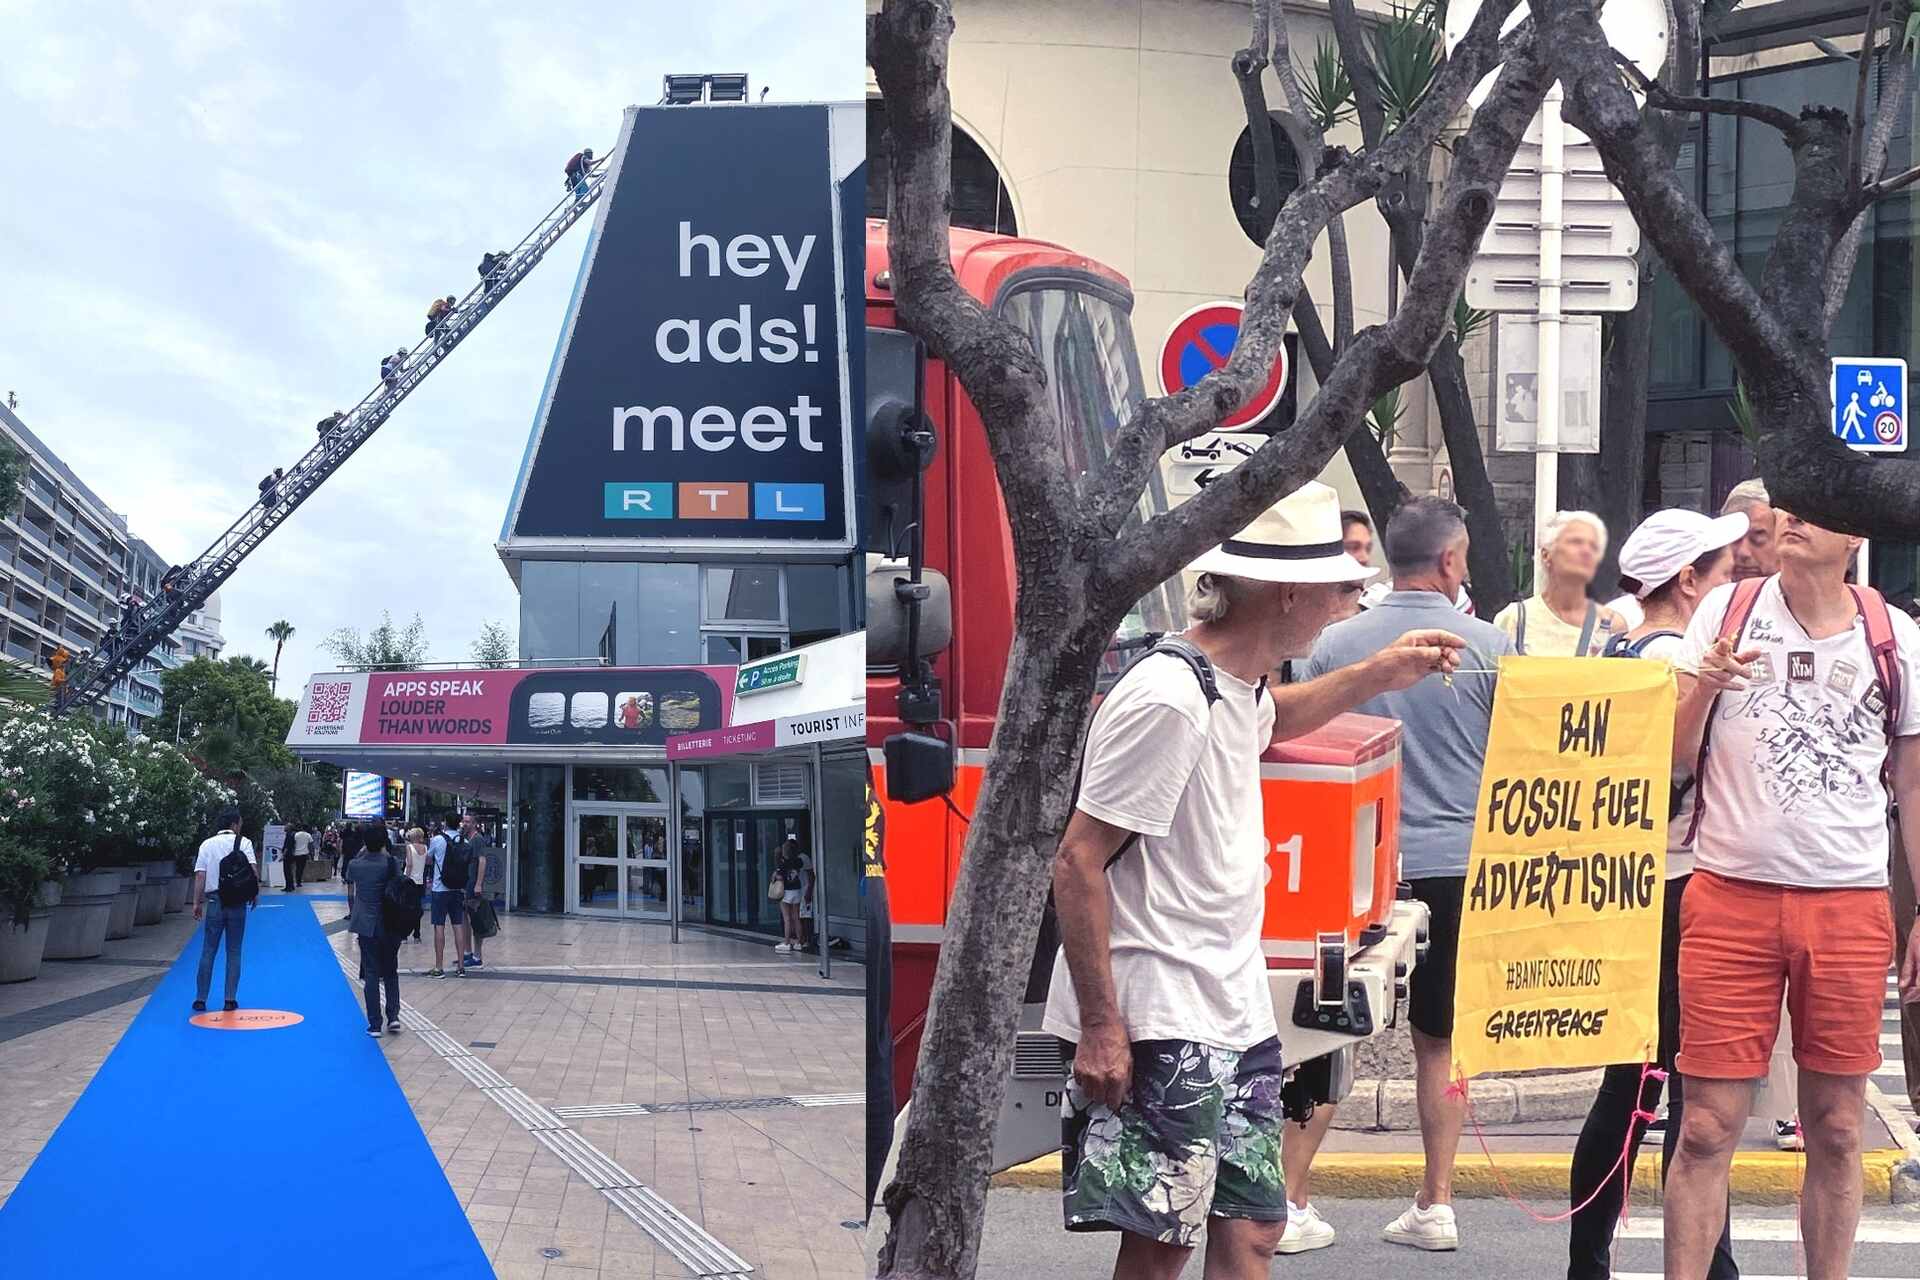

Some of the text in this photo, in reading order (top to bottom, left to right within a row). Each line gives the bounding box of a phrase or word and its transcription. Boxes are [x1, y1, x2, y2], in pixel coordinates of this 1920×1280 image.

[678, 221, 816, 291] hey
[655, 304, 818, 364] ads!
[612, 395, 824, 452] meet
[1880, 422, 1895, 434] 20
[383, 680, 483, 697] APPS SPEAK
[750, 670, 760, 687] P
[380, 700, 445, 715] LOUDER
[378, 718, 492, 735] THAN WORDS
[677, 731, 757, 751] BILLETTERIE TICKETING
[790, 717, 841, 736] TOURIST
[1558, 697, 1611, 757] BAN
[1488, 776, 1654, 837] FOSSIL FUEL
[1470, 850, 1656, 918] ADVERTISING
[1506, 958, 1602, 991] #BANFOSSILADS
[1485, 1007, 1608, 1044] GREENPEACE
